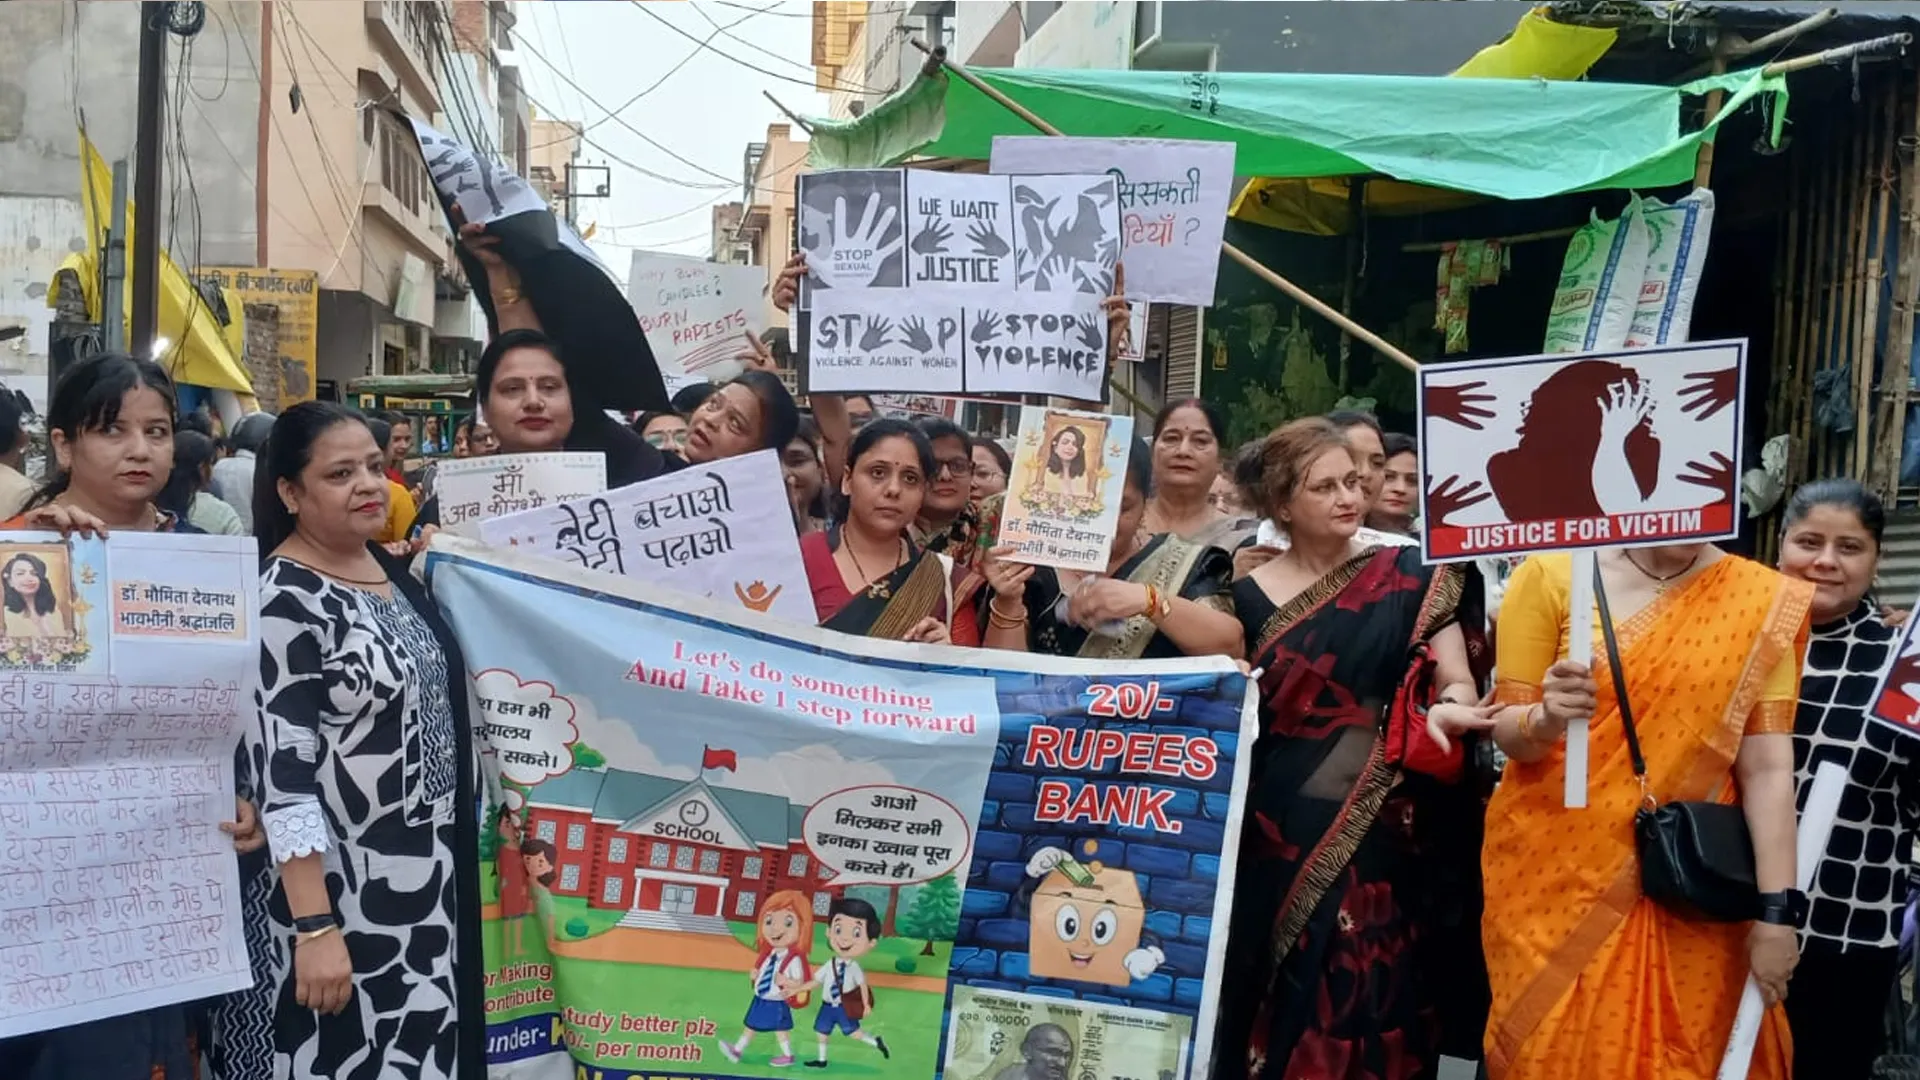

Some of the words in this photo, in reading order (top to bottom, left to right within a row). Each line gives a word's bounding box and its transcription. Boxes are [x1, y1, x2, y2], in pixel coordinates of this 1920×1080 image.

[919, 196, 942, 216] WE
[951, 200, 999, 220] WANT
[834, 248, 873, 261] STOP
[917, 256, 999, 283] JUSTICE
[672, 309, 747, 346] RAPISTS
[1005, 314, 1076, 339] STOP
[815, 357, 863, 369] VIOLENCE
[868, 356, 914, 369] AGAINST
[920, 358, 957, 368] WOMEN
[975, 345, 1099, 377] VIOLENCE
[492, 465, 524, 498] माँ
[633, 471, 734, 530] बचाओ
[1460, 520, 1556, 550] JUSTICE
[1564, 514, 1611, 541] FOR
[1617, 509, 1702, 537] VICTIM
[122, 584, 139, 601] डॉ.
[144, 585, 187, 605] मौमिता
[192, 588, 236, 606] देवनाथ
[120, 610, 174, 627] भावभीनी
[179, 612, 235, 630] श्रद्धांजलि
[673, 641, 740, 672] Let's
[750, 661, 782, 682] do
[791, 672, 932, 711] something
[497, 701, 524, 715] हम
[528, 702, 551, 719] भी
[625, 659, 686, 690] And
[698, 673, 764, 703] Take
[796, 699, 851, 724] step
[862, 708, 976, 734] forward
[1089, 684, 1173, 718] 20/-
[1023, 726, 1217, 780] RUPEES
[870, 795, 918, 811] आओ
[1034, 781, 1182, 834] BANK.
[653, 821, 725, 845] SCHOOL
[836, 808, 902, 833] मिलकर
[906, 818, 943, 837] सभी
[816, 832, 867, 851] इनका
[872, 840, 918, 857] ख्वाब
[923, 846, 952, 865] पूरा
[844, 860, 887, 876] करते
[620, 1014, 679, 1033] better
[686, 1018, 716, 1039] plz
[595, 1042, 630, 1059] per
[636, 1043, 701, 1060] month
